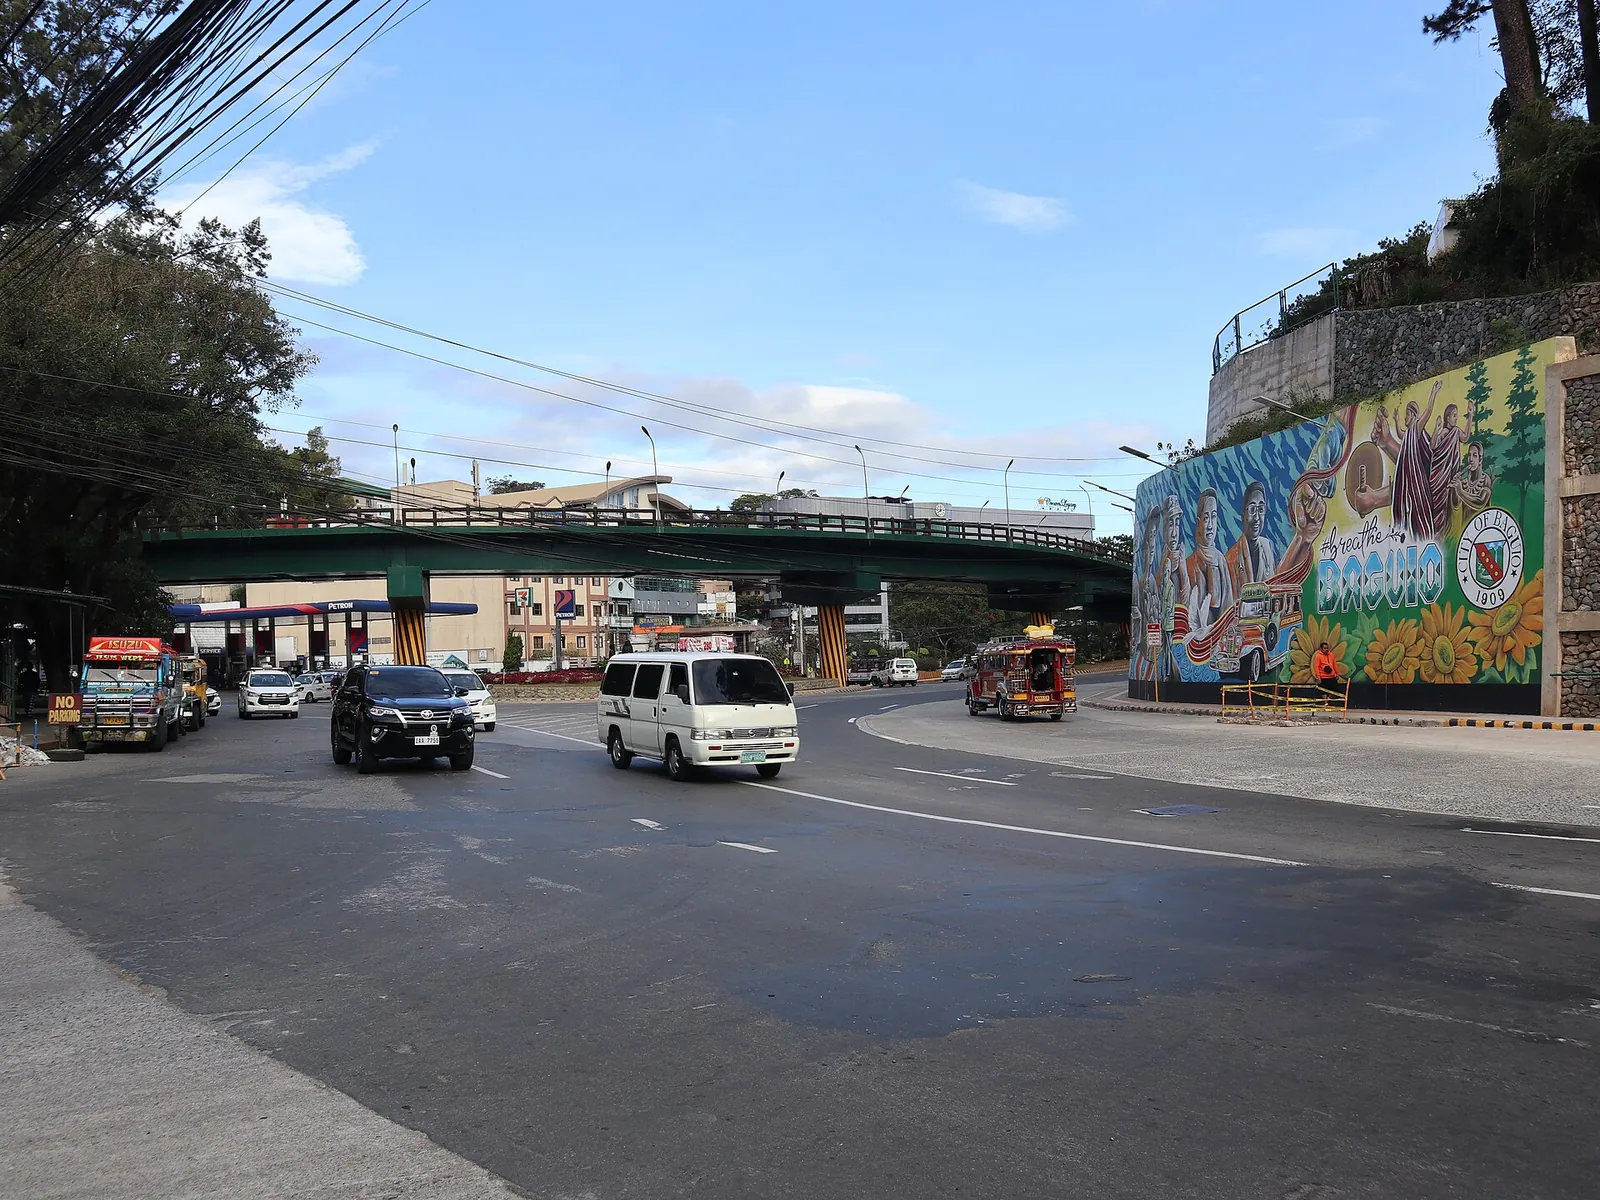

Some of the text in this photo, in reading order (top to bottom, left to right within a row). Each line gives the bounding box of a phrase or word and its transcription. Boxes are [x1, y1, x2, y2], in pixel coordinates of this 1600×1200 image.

[1320, 515, 1391, 561] #breathe
[1459, 511, 1522, 573] CITY OF BAGUIO
[1318, 542, 1444, 614] BAGUIO
[1476, 588, 1505, 605] 1909
[328, 602, 353, 610] PETRON
[108, 640, 143, 649] ISUZU
[55, 695, 75, 709] NO
[48, 709, 81, 723] PARKING
